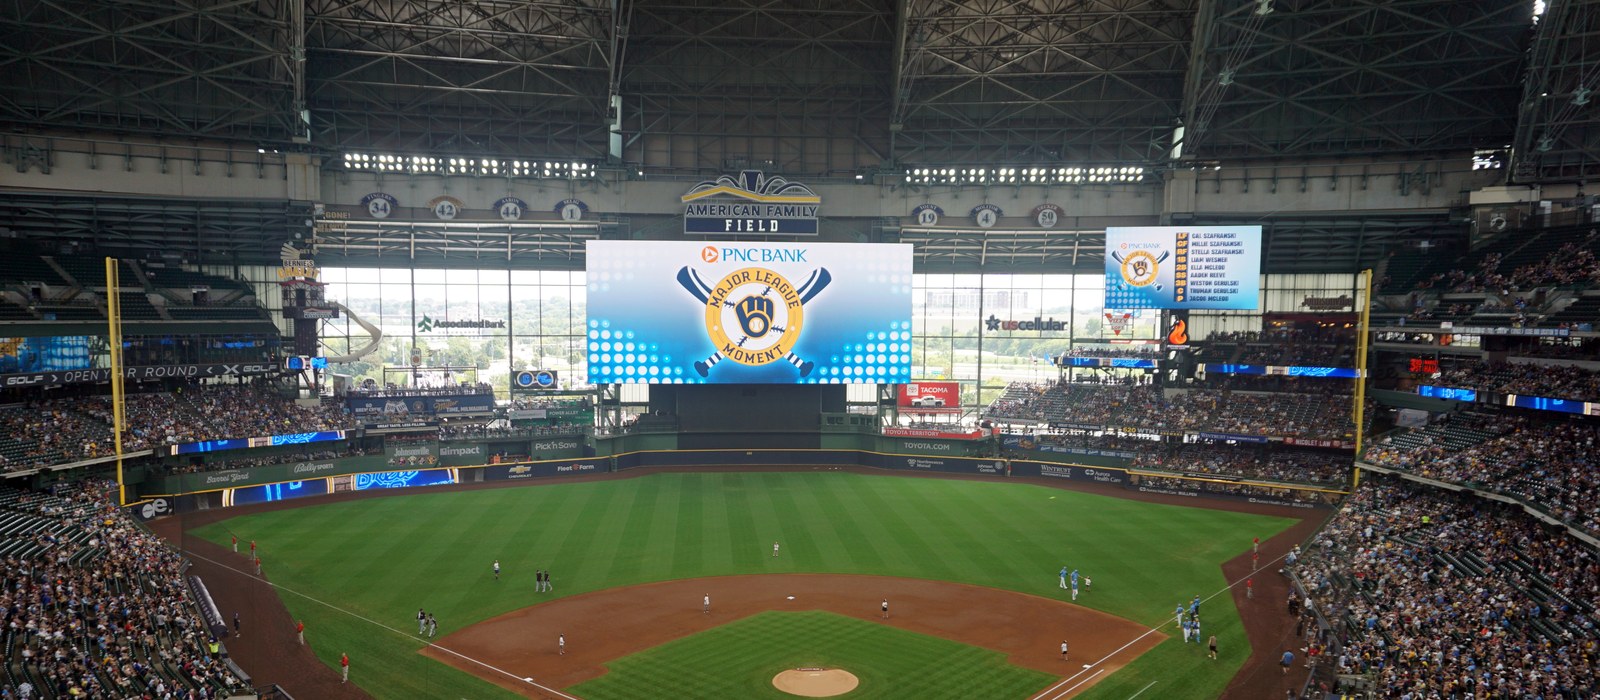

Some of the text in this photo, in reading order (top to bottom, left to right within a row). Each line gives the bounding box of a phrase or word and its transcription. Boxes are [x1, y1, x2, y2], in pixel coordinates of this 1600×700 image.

[372, 203, 388, 214] 34
[438, 205, 453, 216] 42
[503, 207, 519, 218] 44
[569, 209, 574, 218] 1
[686, 205, 817, 217] AMERICAN FAMILY
[922, 213, 934, 222] 19
[982, 214, 988, 224] 4
[1042, 212, 1054, 221] 50
[725, 219, 779, 232] FIELD
[722, 248, 807, 262] PNC BANK
[277, 267, 320, 278] CHALET
[710, 270, 799, 308] MAJOR LEAGUE
[433, 320, 505, 328] Associated Bank
[1002, 317, 1068, 331] uscellular
[723, 343, 783, 364] MOMENT
[64, 366, 197, 382] OPEN YR ROUND
[7, 375, 43, 385] GOLF
[447, 446, 480, 456] impact
[904, 442, 950, 450] TOYOTA.COM
[294, 463, 318, 473] Bally
